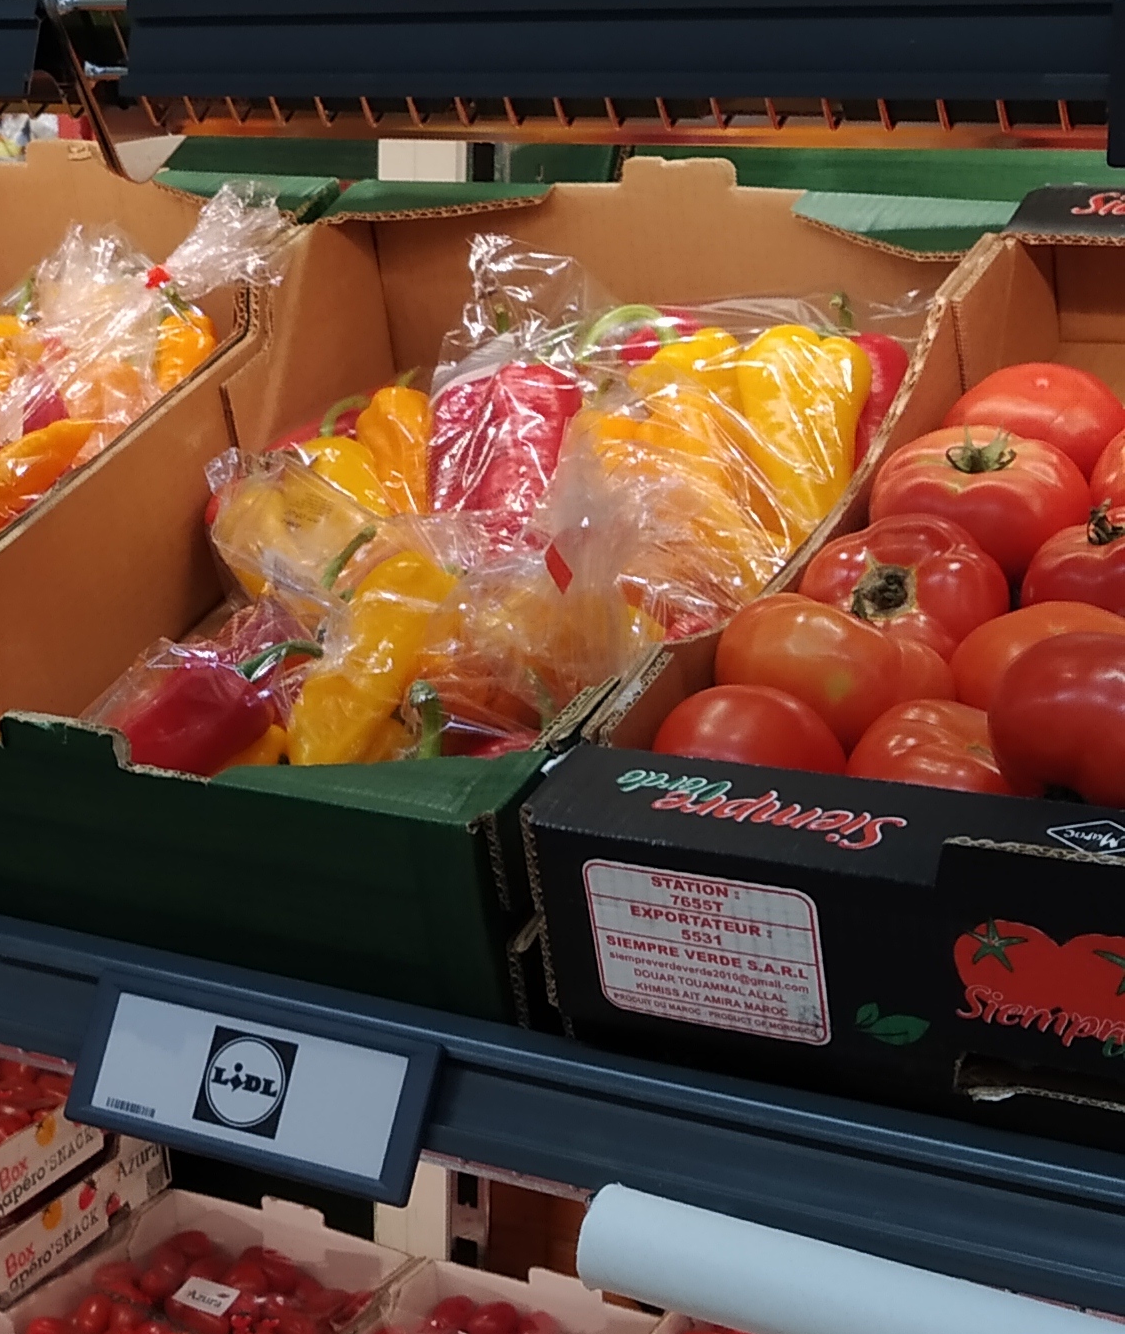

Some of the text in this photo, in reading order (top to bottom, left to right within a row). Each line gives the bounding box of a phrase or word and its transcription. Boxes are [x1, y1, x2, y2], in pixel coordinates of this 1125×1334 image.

[651, 875, 730, 898] STATION
[670, 894, 725, 913] 7655T
[630, 905, 762, 938] EXPORTATEUR
[681, 929, 723, 946] 5531
[606, 935, 680, 958] SIEMPRE
[684, 949, 742, 969] VERDE
[634, 968, 676, 983] DOUAR
[748, 989, 787, 1004] ALLAL
[636, 982, 789, 1017] KHMISS AIT AMIRA MAROC
[668, 1003, 701, 1016] MAROC
[4, 1242, 36, 1279] Box
[188, 1288, 223, 1309] Azura
